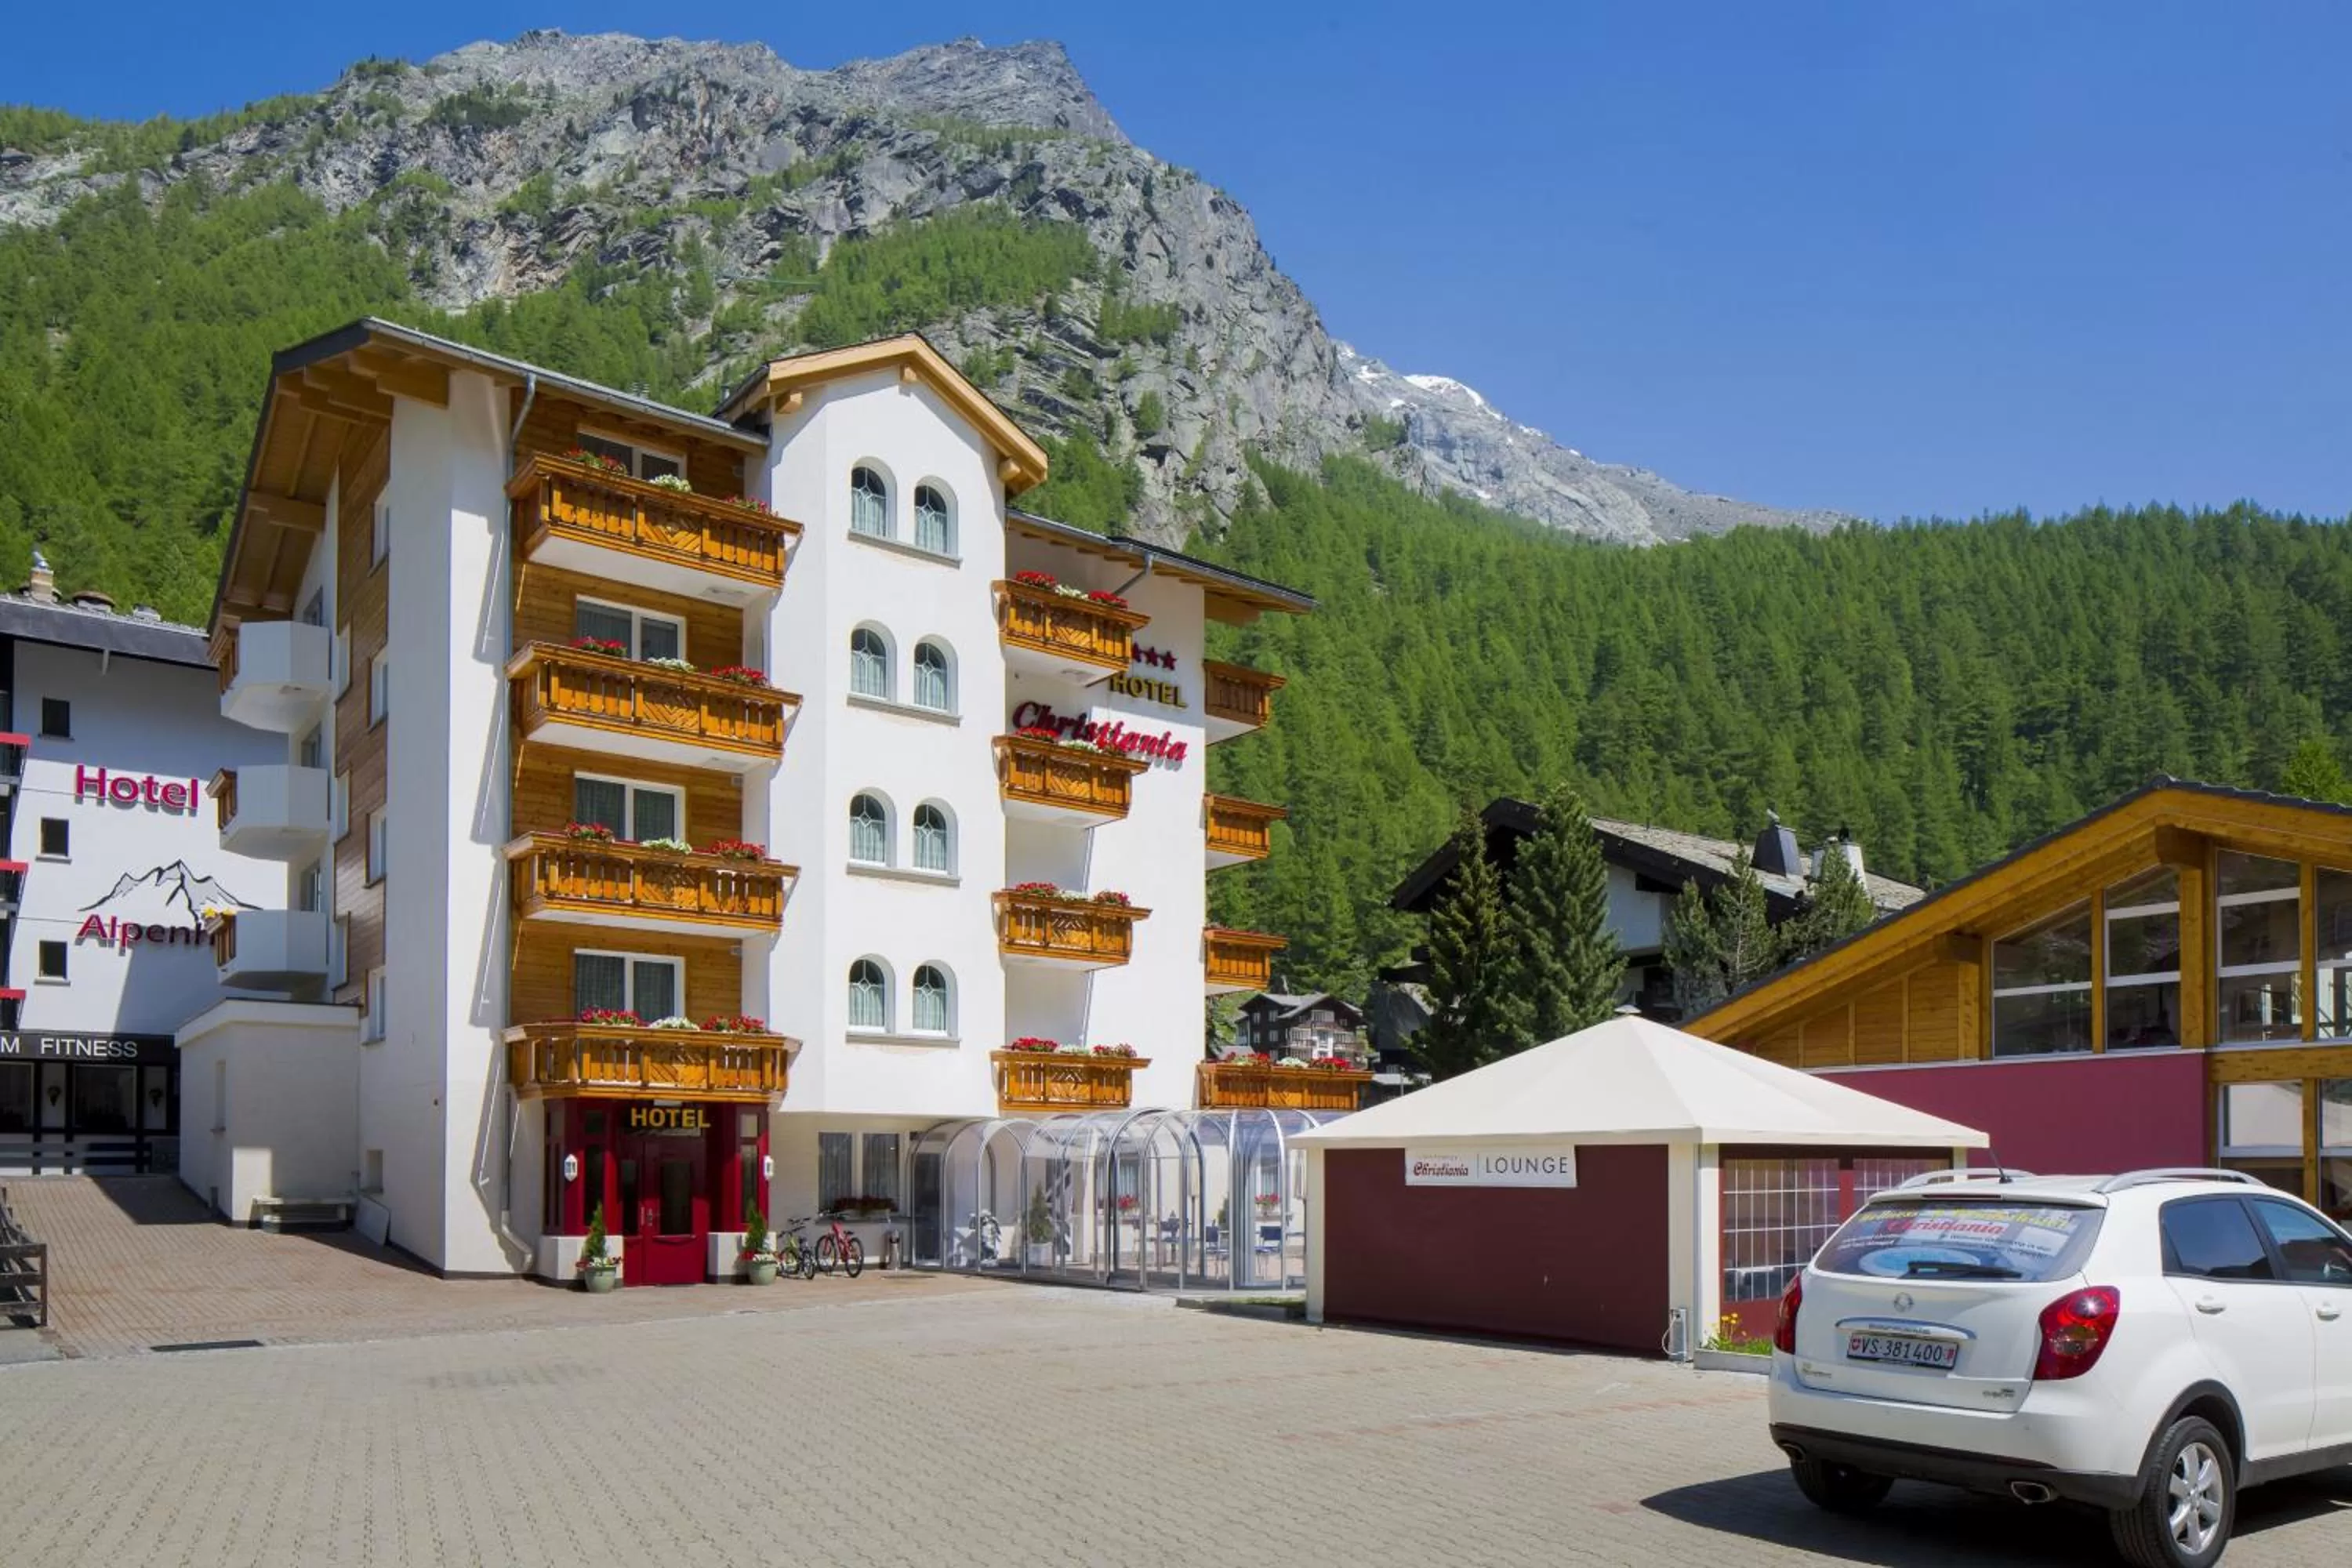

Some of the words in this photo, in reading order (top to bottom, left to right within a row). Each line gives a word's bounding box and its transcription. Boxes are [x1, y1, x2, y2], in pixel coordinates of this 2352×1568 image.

[1110, 674, 1188, 708] HOTEL
[1013, 701, 1188, 760] Christiania
[76, 764, 199, 808] Hotel
[41, 1037, 138, 1058] FITNESS
[631, 1107, 711, 1128] HOTEL
[1413, 1161, 1469, 1177] Christiania
[1486, 1156, 1568, 1174] LOUNGE
